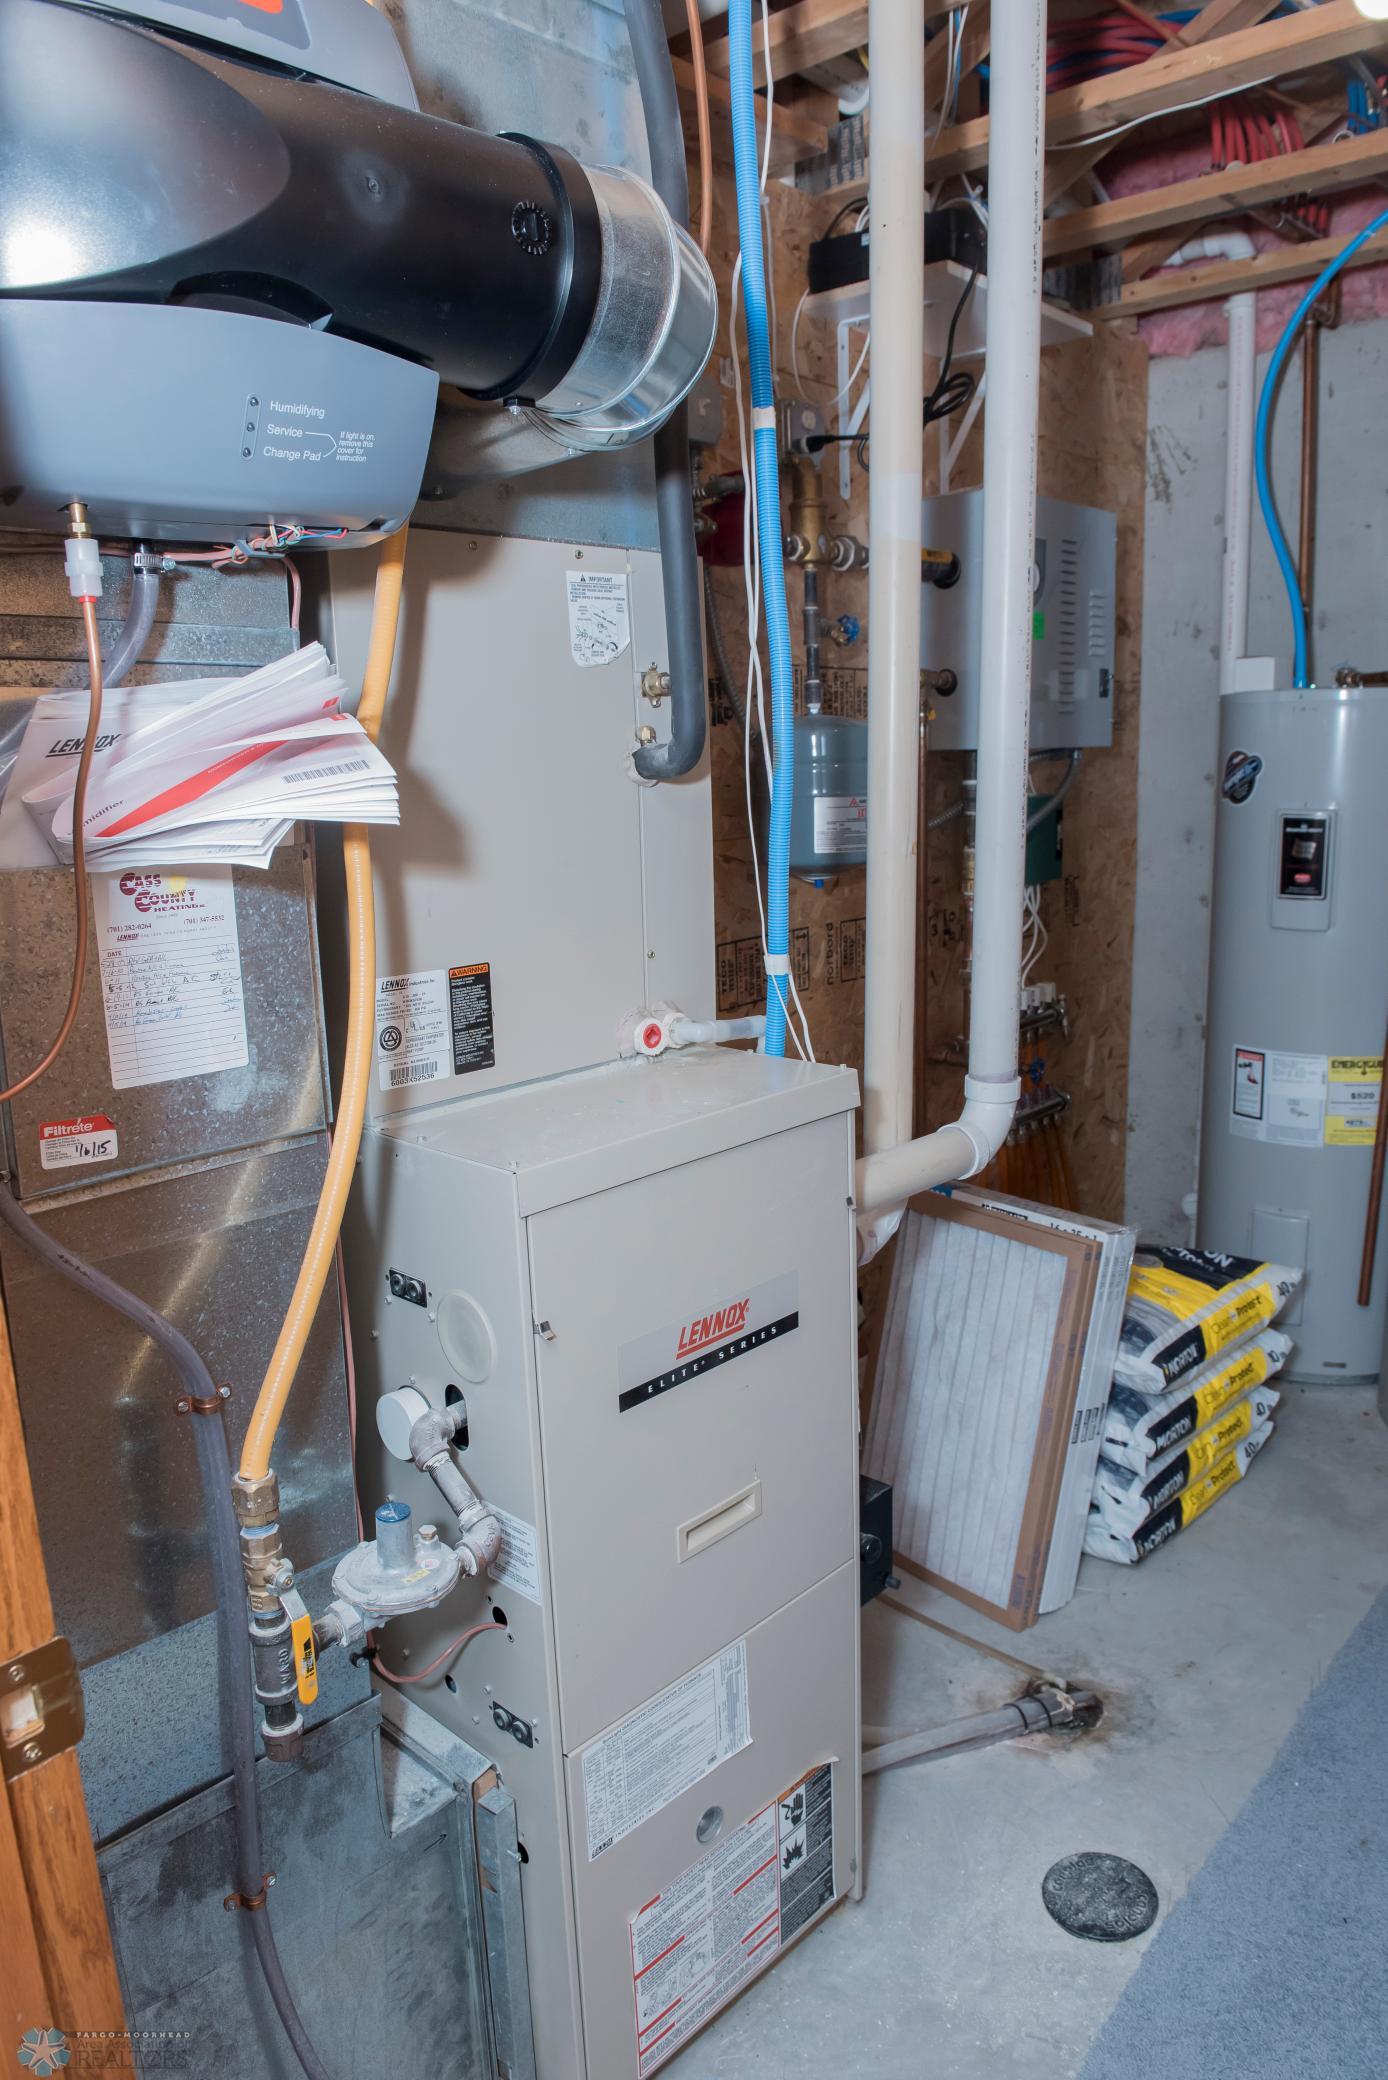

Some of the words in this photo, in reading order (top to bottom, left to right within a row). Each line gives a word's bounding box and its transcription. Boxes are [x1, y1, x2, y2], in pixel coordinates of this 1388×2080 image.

[269, 400, 325, 420] Humidifying
[266, 423, 303, 438] Service
[340, 431, 345, 439] If
[345, 431, 358, 441] light
[359, 431, 364, 440] is
[263, 446, 301, 462] Change
[303, 449, 322, 461] Pad
[337, 447, 354, 455] cover
[355, 447, 364, 455] for
[338, 440, 362, 448] remove
[363, 440, 374, 448] this
[335, 453, 367, 462] instruction
[49, 733, 122, 754] LENOX
[119, 872, 162, 896] CASS
[134, 889, 196, 913] COUNTY
[107, 926, 123, 934] (701)
[107, 950, 122, 958] DATE
[826, 922, 834, 986] norbord
[457, 965, 488, 977] WARNING
[381, 978, 410, 993] LENNOX
[43, 1120, 95, 1138] Filtrete
[677, 1298, 750, 1355] LENNOX
[647, 1362, 700, 1394] ELITE
[718, 1326, 777, 1361] SERIES
[1168, 1341, 1199, 1378] MORTON
[1155, 1414, 1192, 1451] MORTON
[1211, 1458, 1237, 1487] Protect
[1244, 1441, 1256, 1459] 40
[1153, 1471, 1185, 1509] MORTON
[1144, 1518, 1176, 1551] MORTON
[278, 1647, 291, 1685] WARD
